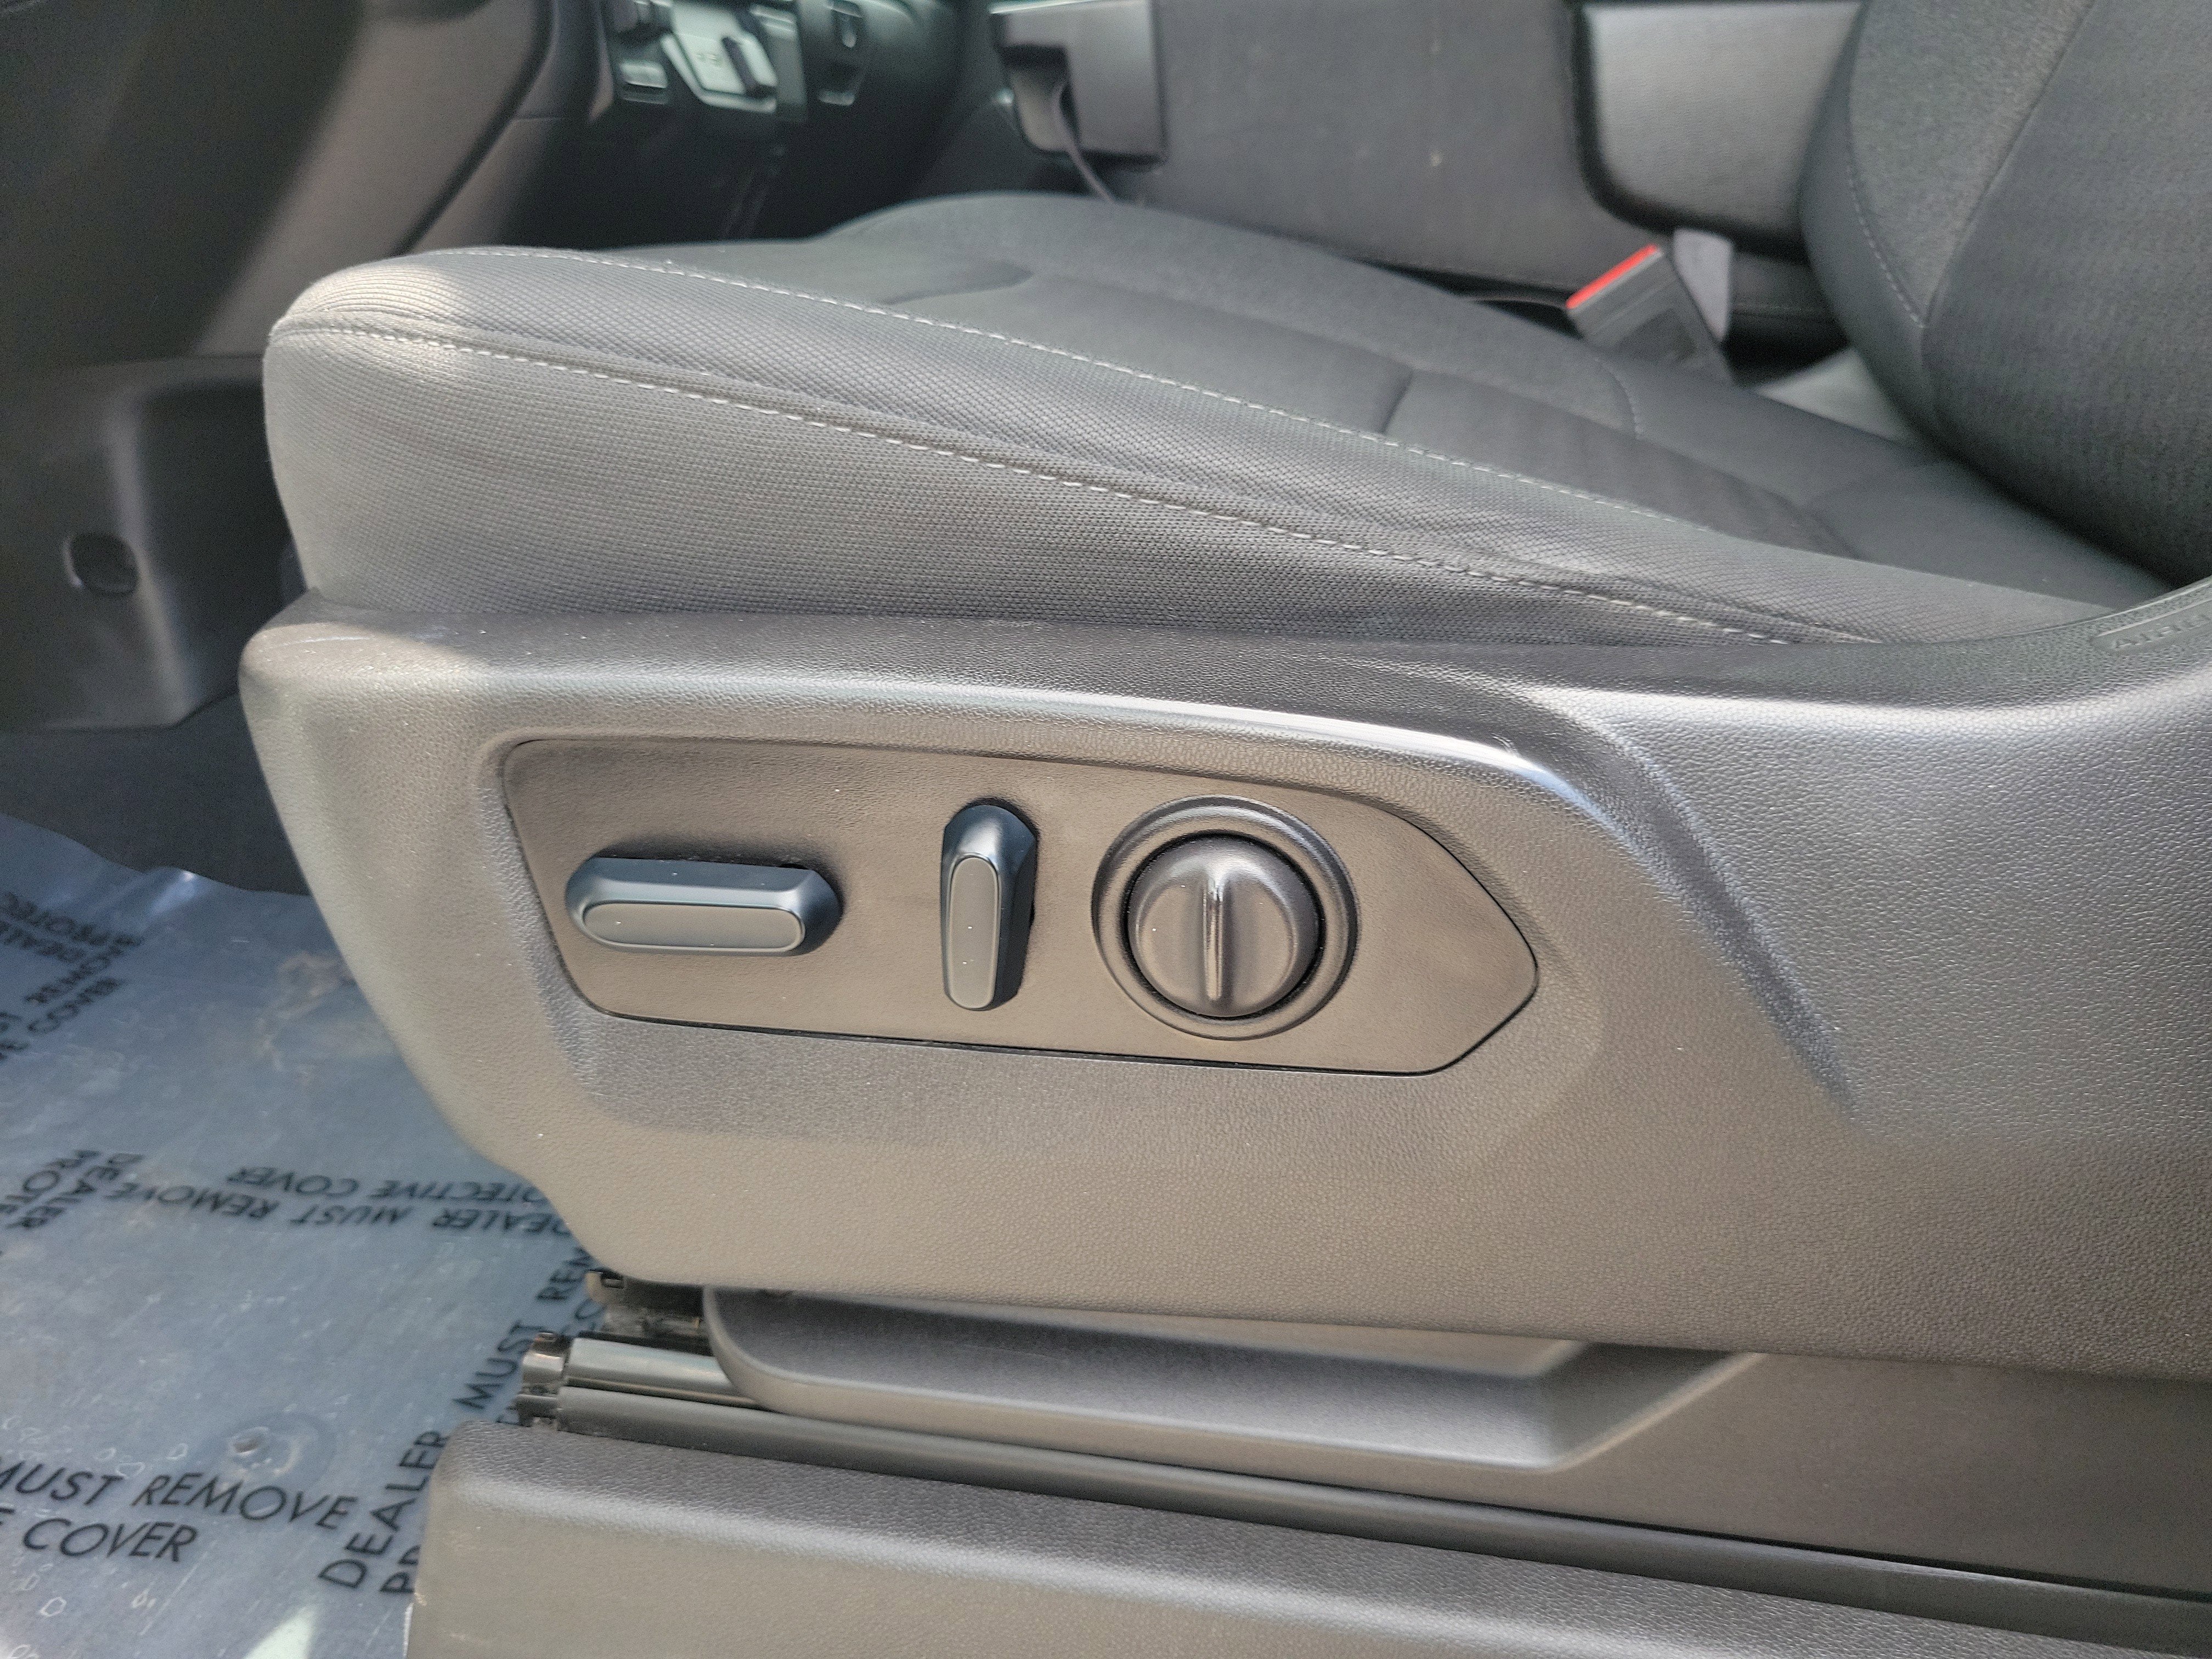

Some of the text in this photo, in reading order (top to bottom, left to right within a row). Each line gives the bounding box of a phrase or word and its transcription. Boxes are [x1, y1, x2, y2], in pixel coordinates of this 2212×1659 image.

[287, 1203, 414, 1226] MUST
[129, 1471, 359, 1531] REMOVE
[317, 1430, 451, 1590] DEALER
[22, 1516, 199, 1562] COVER
